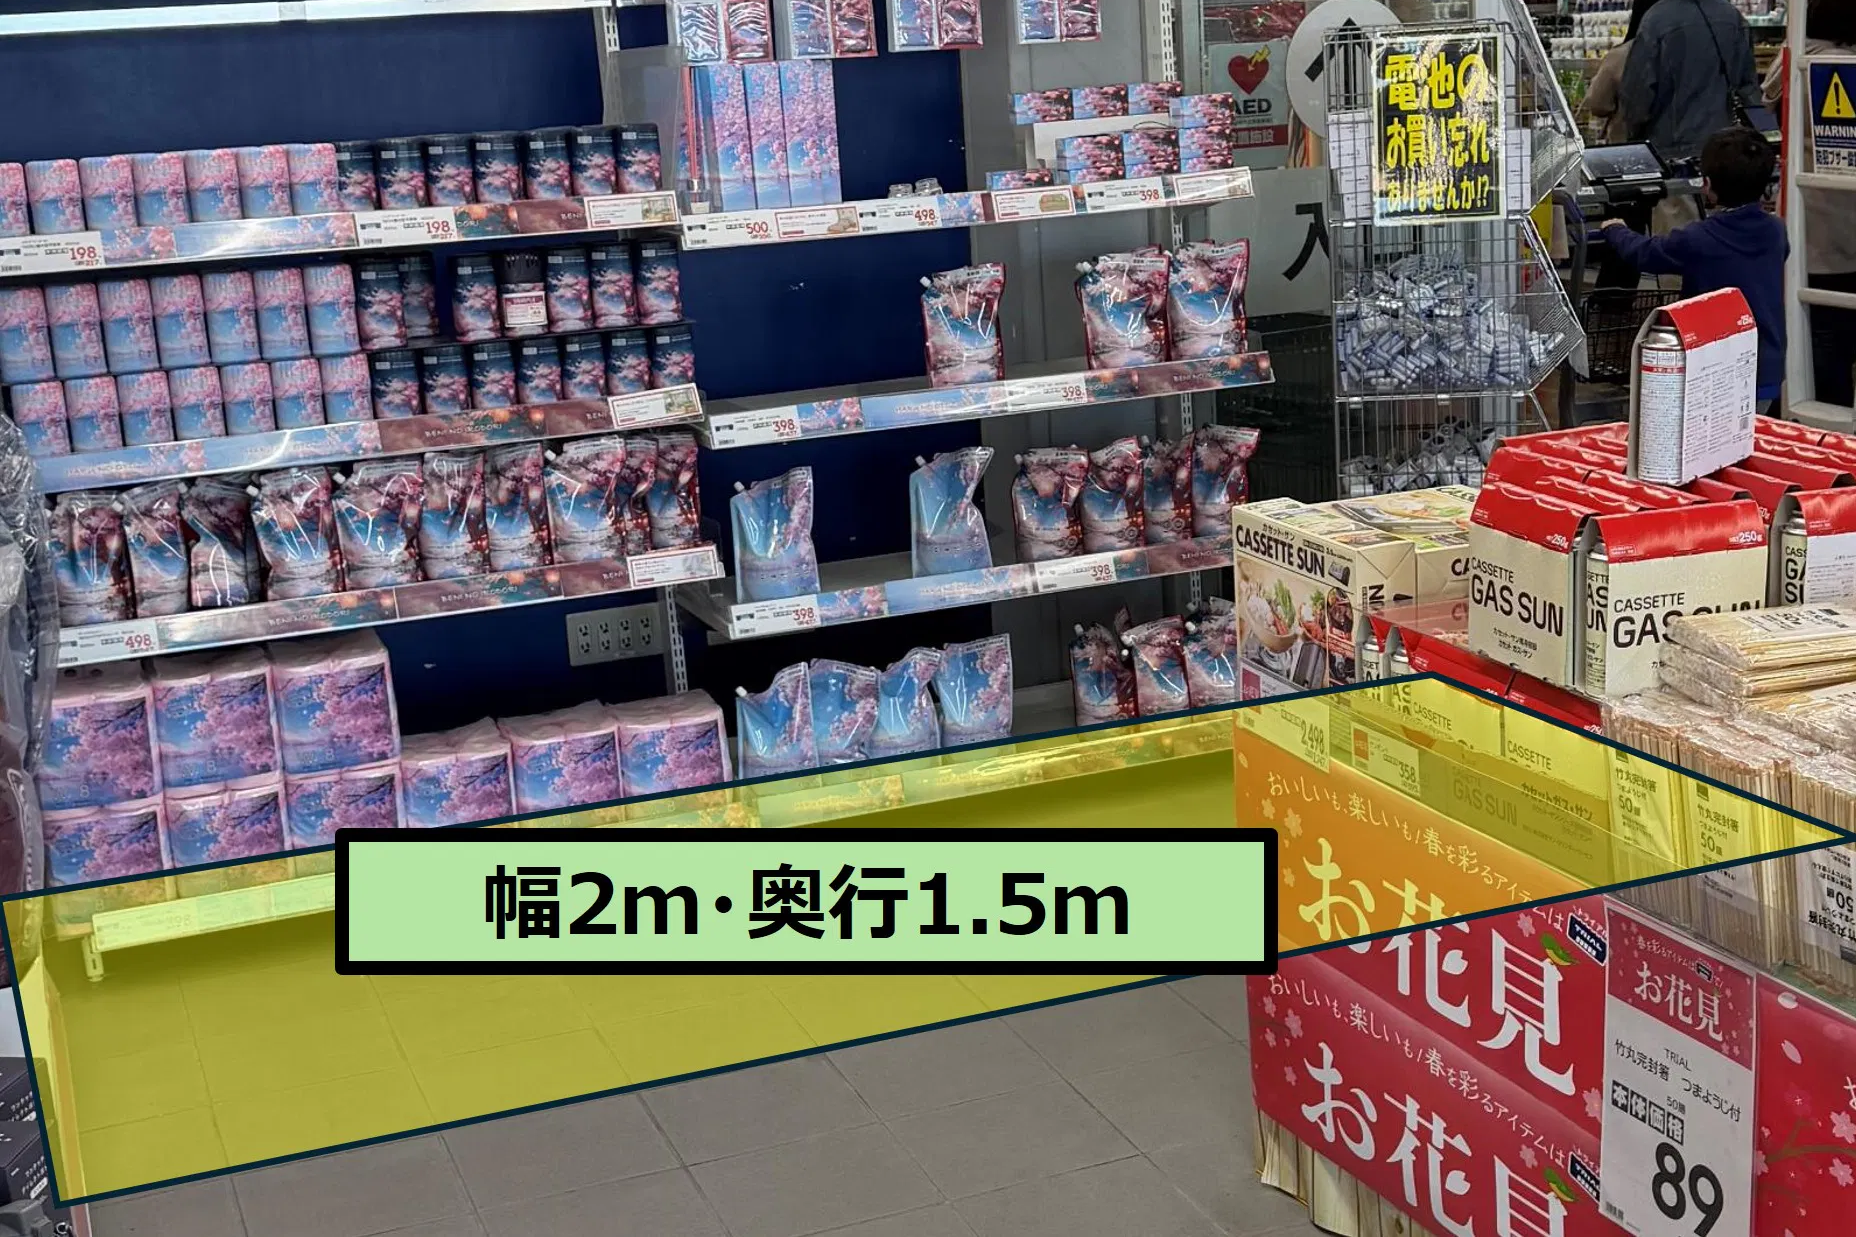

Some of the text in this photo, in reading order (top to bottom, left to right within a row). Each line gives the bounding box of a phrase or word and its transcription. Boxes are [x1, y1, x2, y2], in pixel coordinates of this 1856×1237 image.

[1385, 53, 1490, 112] 電池の
[1385, 114, 1490, 168] お買い忘れ
[1139, 189, 1160, 202] 398
[426, 221, 452, 234] 198
[746, 221, 770, 235] 500
[914, 209, 937, 221] 498
[70, 247, 96, 260] 198
[1063, 386, 1084, 398] 398
[773, 419, 796, 433] 398
[1236, 524, 1325, 578] CASSETTE SUN
[1472, 557, 1514, 584] CASSETTE
[793, 608, 817, 621] 398
[1472, 575, 1513, 616] GAS
[1518, 592, 1563, 637] SUN
[1614, 593, 1685, 613] CASSETTE
[125, 634, 153, 647] 498
[1413, 703, 1452, 731] CASSETTE
[1299, 837, 1576, 1097] お花見
[1635, 961, 1723, 1043] お花見
[1664, 1046, 1692, 1071] TRIAL
[1615, 1038, 1741, 1123] 竹丸完封箸 つまようじ付
[1612, 1079, 1685, 1145] 本体価格
[1652, 1141, 1724, 1237] 89
